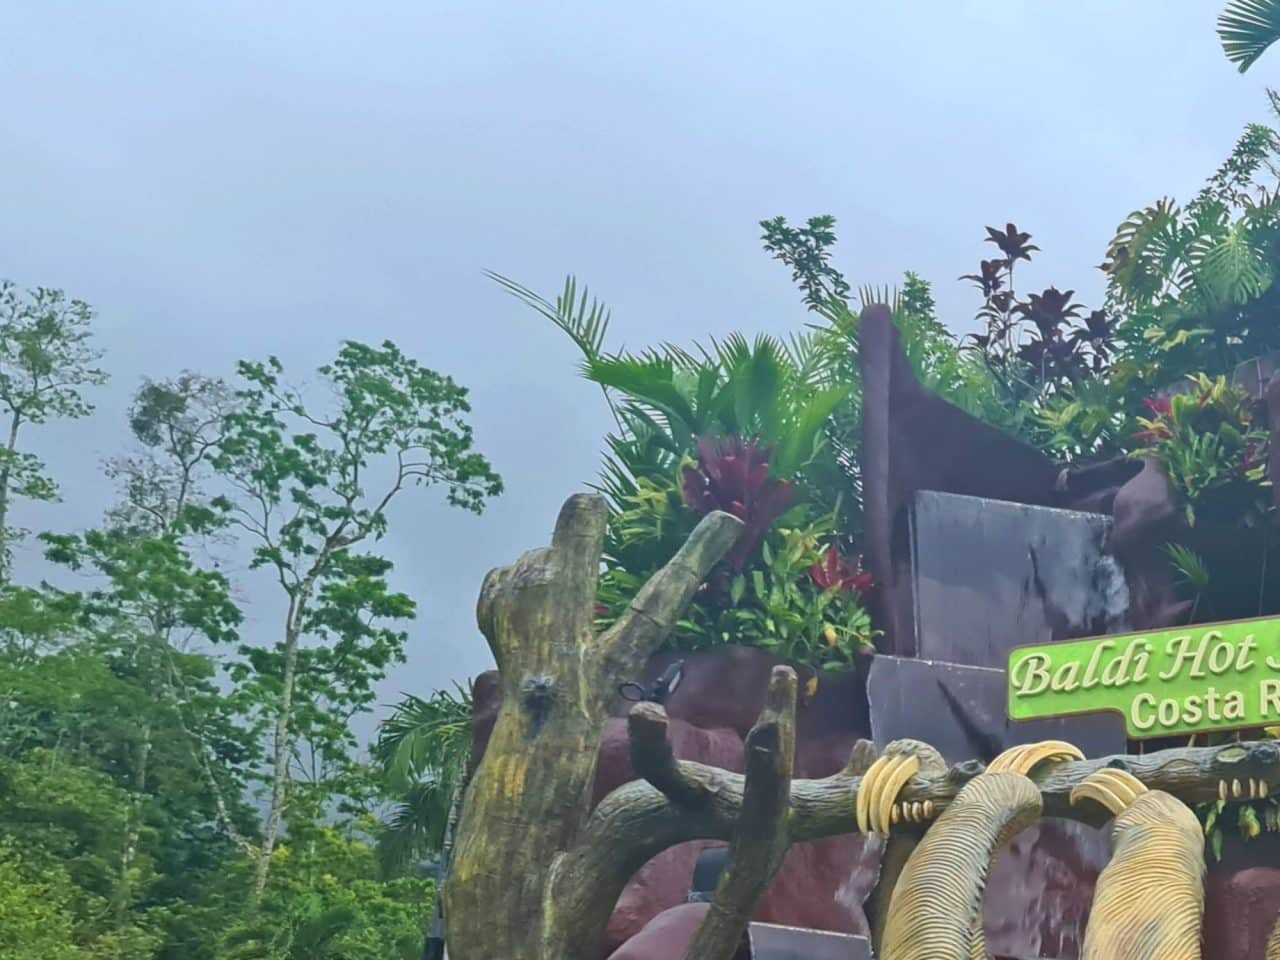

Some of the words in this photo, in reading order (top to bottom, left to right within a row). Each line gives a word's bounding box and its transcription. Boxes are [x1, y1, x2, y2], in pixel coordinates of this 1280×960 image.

[1010, 638, 1152, 697] Baldi
[1158, 629, 1257, 683] Hot
[1130, 686, 1246, 731] Costa
